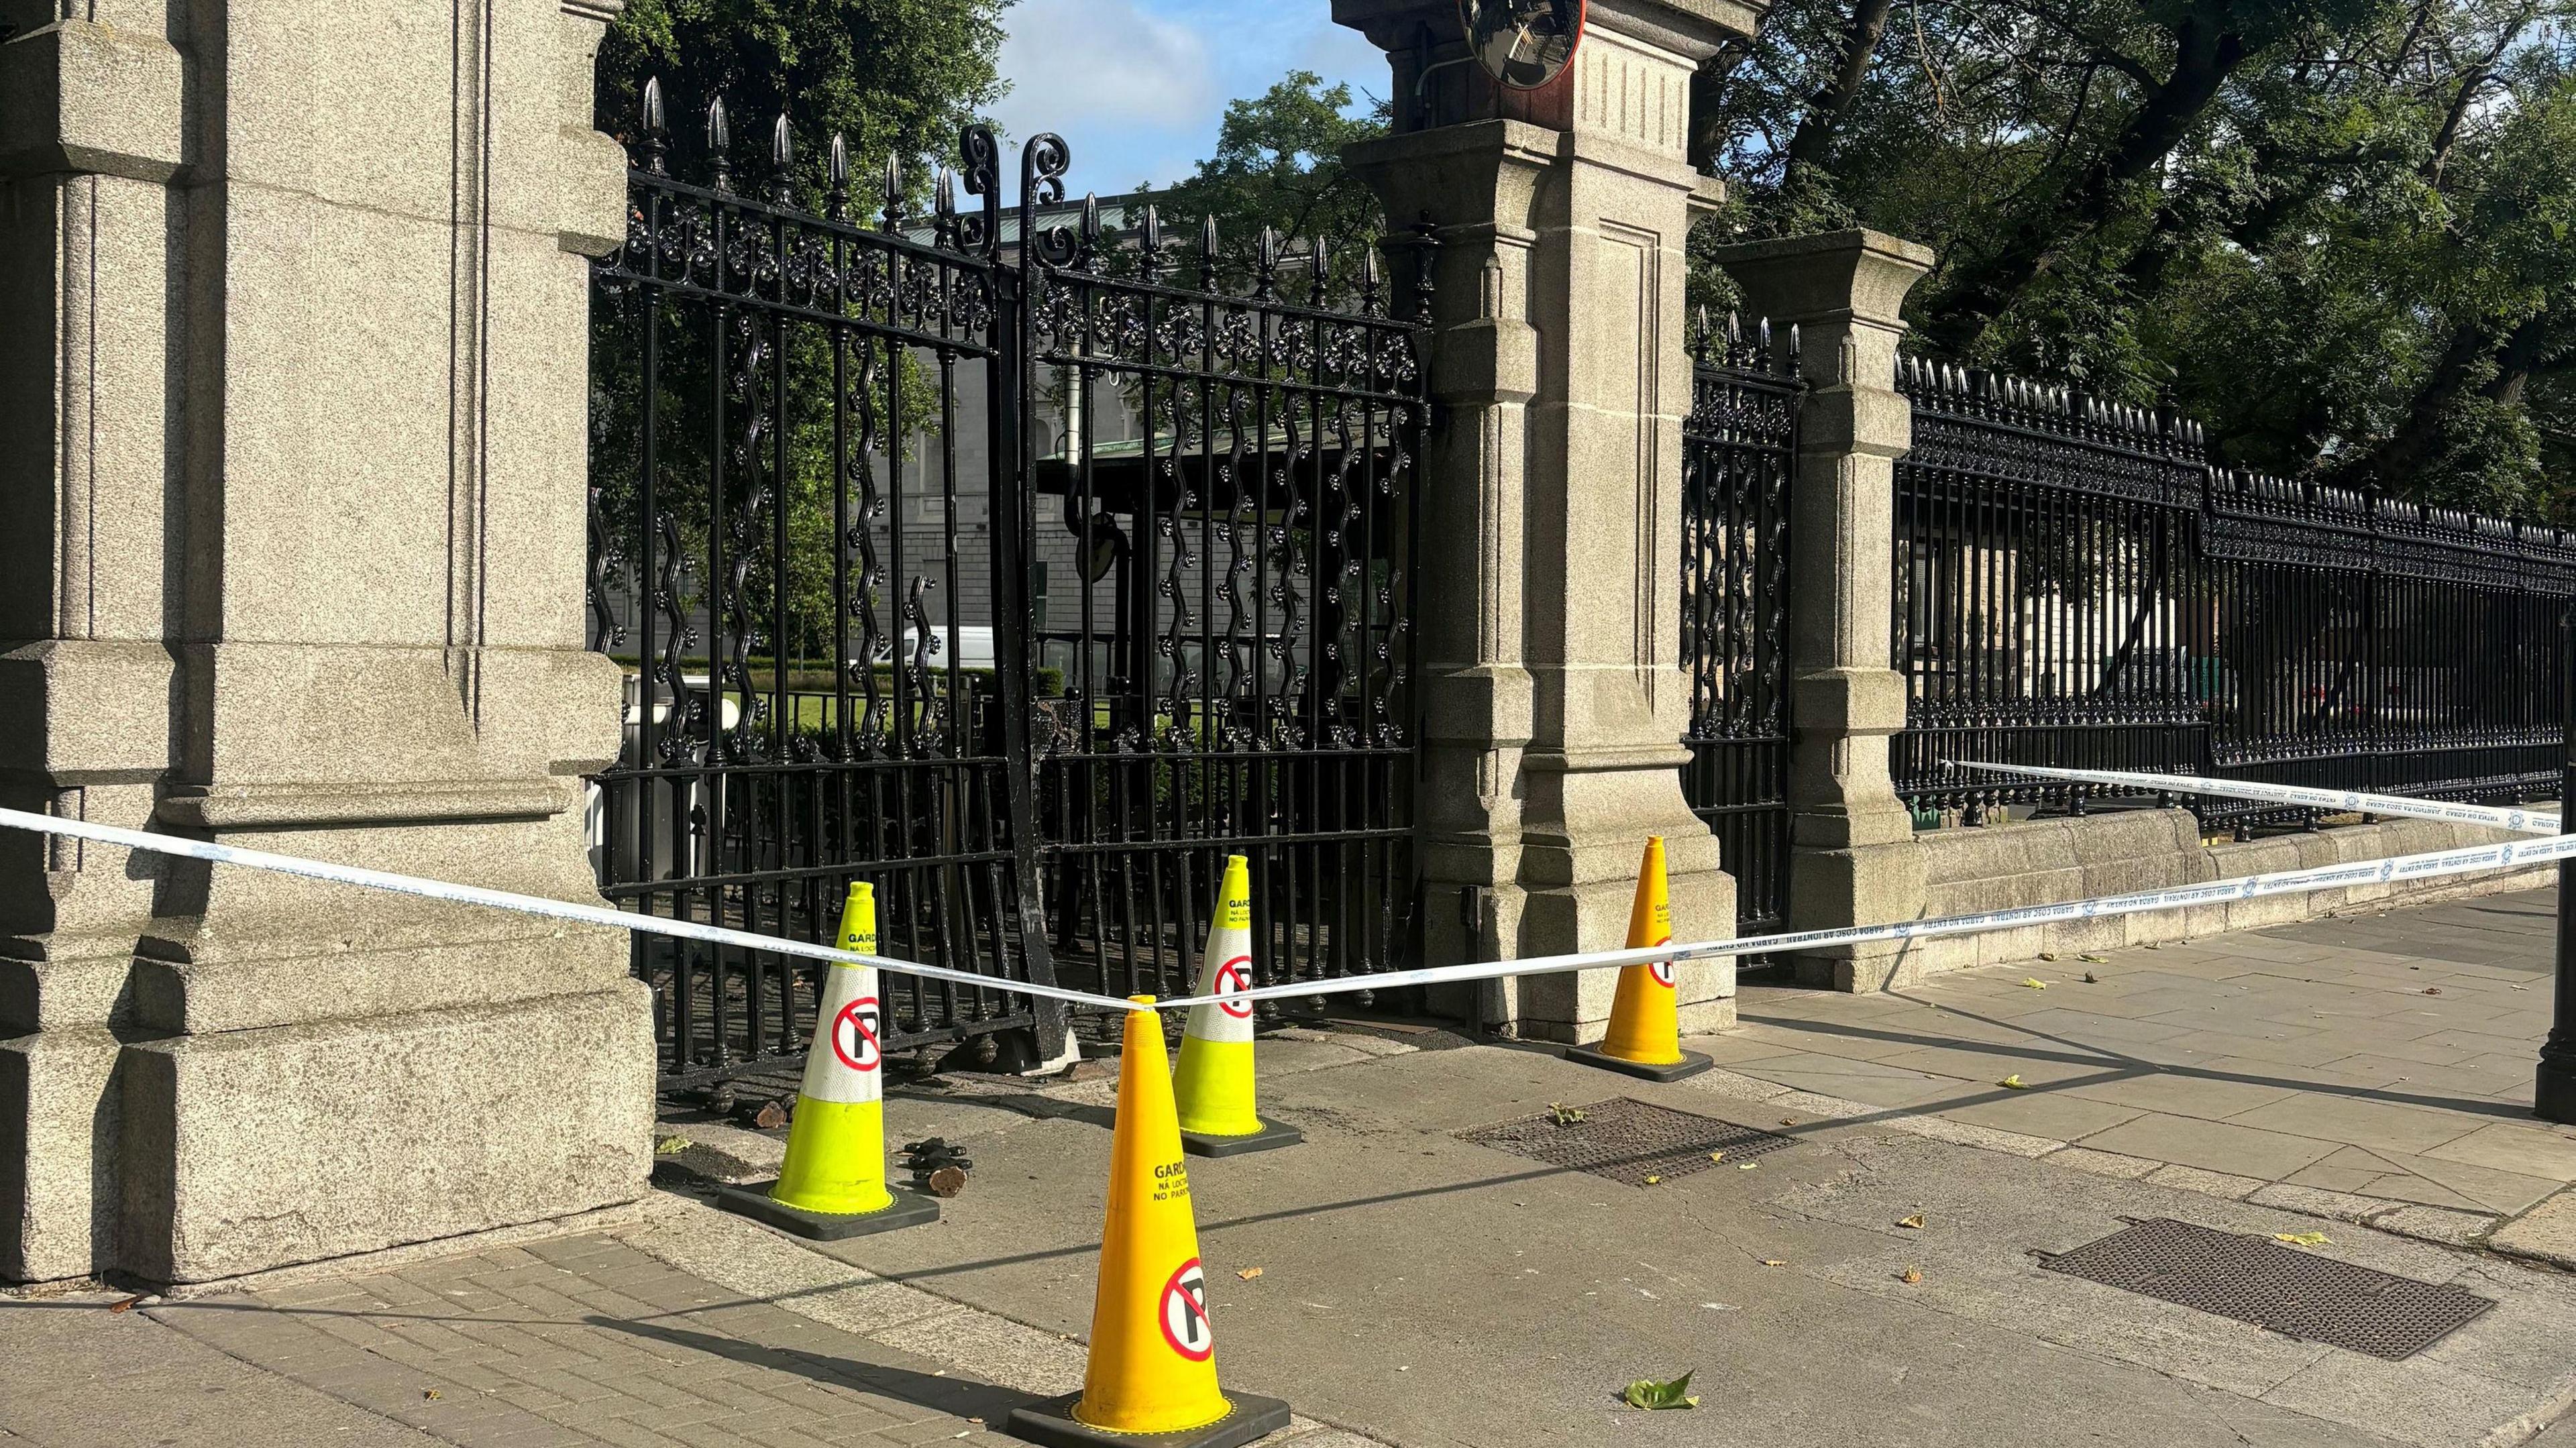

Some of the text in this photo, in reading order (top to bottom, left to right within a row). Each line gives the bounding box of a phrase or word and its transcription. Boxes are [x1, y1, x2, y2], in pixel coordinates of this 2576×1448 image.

[2198, 889, 2216, 898] COSC
[2216, 887, 2236, 896] GARDA
[2127, 899, 2138, 907] NO
[2139, 896, 2159, 905] GARDA
[1655, 903, 1669, 911] GAR
[2032, 907, 2051, 917] COSC
[2052, 905, 2075, 915] GARDA
[2021, 909, 2033, 918] AR
[1922, 918, 1947, 930] ENTRY
[1947, 917, 1960, 927] NO
[1960, 914, 1985, 925] GARDA
[1823, 930, 1833, 939] AR
[1835, 928, 1858, 938] COSC
[1858, 925, 1884, 935] GARDA
[849, 934, 875, 943] GARD
[1154, 1161, 1185, 1178] GARD
[1159, 1178, 1170, 1190] NÁ
[1154, 1188, 1189, 1201] NO PARK
